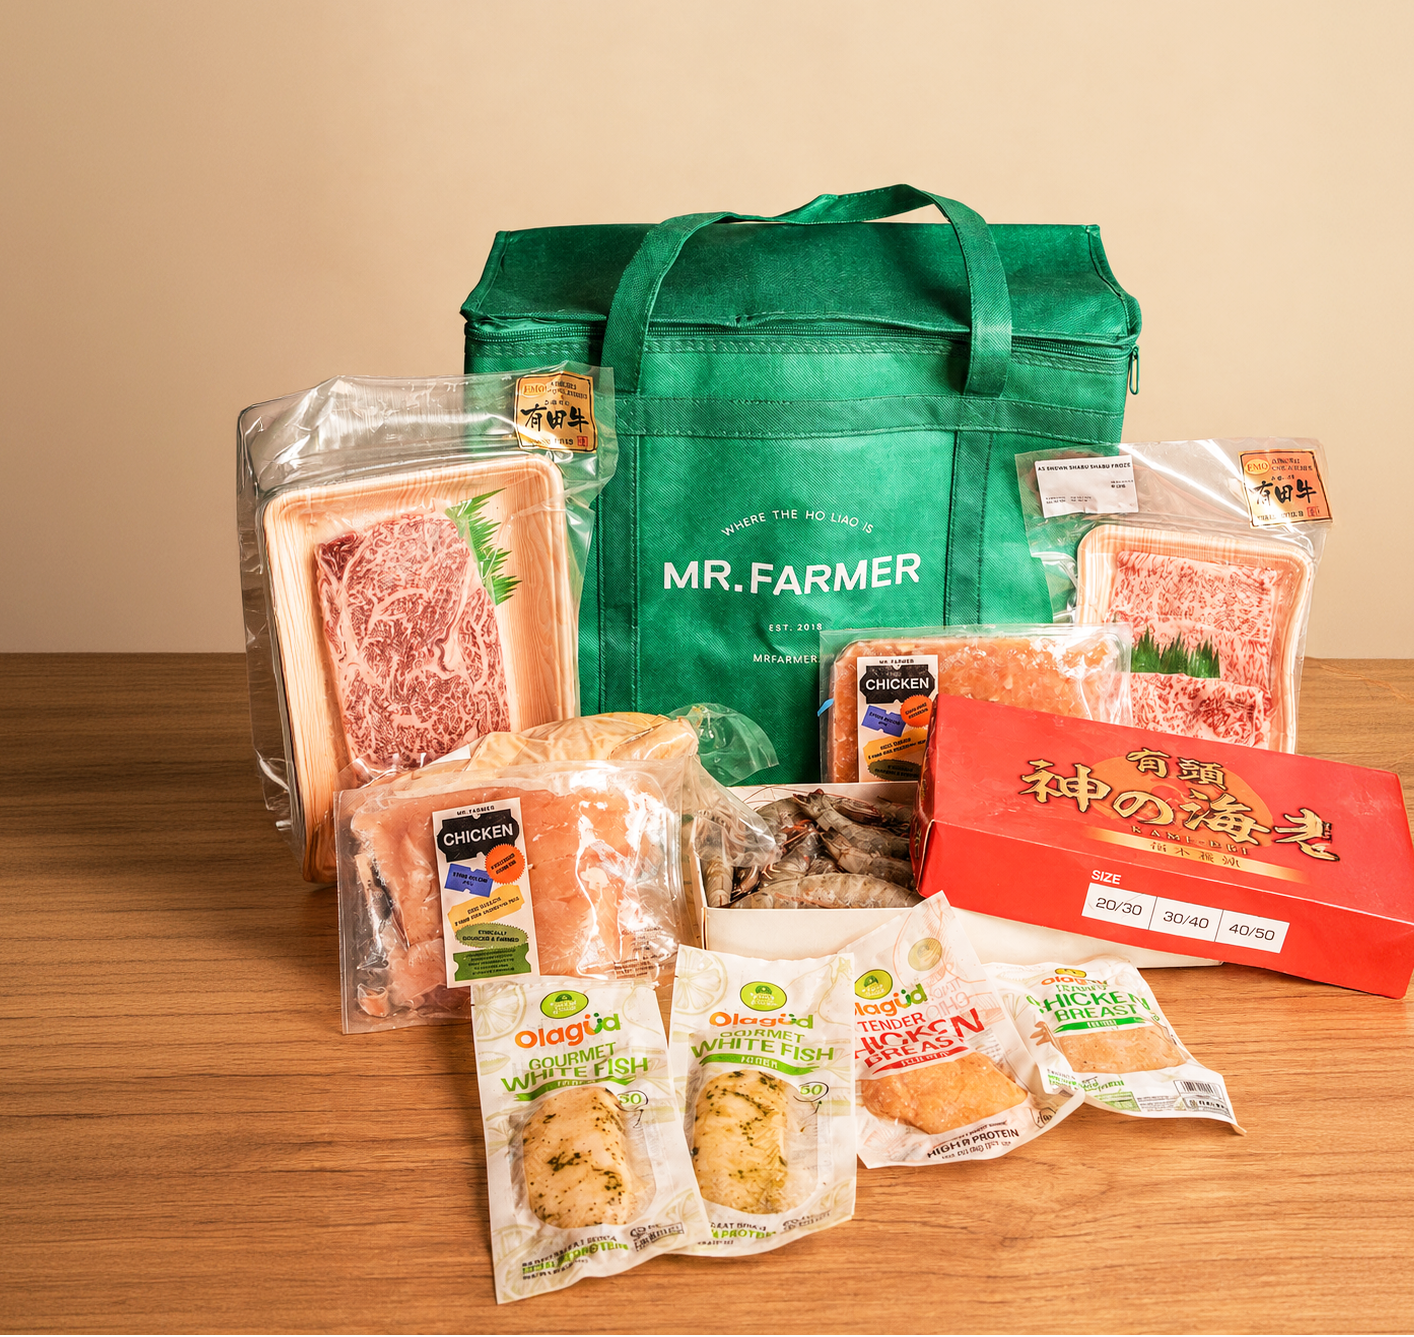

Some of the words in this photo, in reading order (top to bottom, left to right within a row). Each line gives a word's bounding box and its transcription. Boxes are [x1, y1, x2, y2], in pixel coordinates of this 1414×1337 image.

[520, 403, 589, 433] 有田牛
[721, 512, 766, 537] WHERE
[772, 509, 798, 520] THE
[805, 510, 825, 521] HO
[830, 512, 859, 528] LIAO
[862, 522, 875, 534] IS
[768, 623, 793, 632] EST.
[797, 622, 823, 632] 2018
[865, 677, 929, 690] CHICKEN
[1126, 747, 1228, 790] 有頭
[443, 823, 514, 846] CHICKEN
[1091, 869, 1121, 885] SIZE
[1095, 897, 1142, 916] 20/30
[1163, 911, 1209, 929] 30/40
[1229, 923, 1275, 941] 40/50
[855, 983, 928, 1017] lagüd
[1054, 1004, 1138, 1022] BREAST
[515, 1013, 621, 1049] Olagüd
[709, 1011, 813, 1029] Olagüd
[857, 1012, 926, 1032] TENDER
[855, 1008, 985, 1059] HICKEN
[529, 1042, 616, 1070] GOURMET
[691, 1038, 775, 1058] WHITE
[780, 1042, 834, 1062] FISH
[501, 1066, 587, 1092] WHITE
[594, 1057, 648, 1077] FISH
[972, 1129, 1020, 1144] PROTEIN
